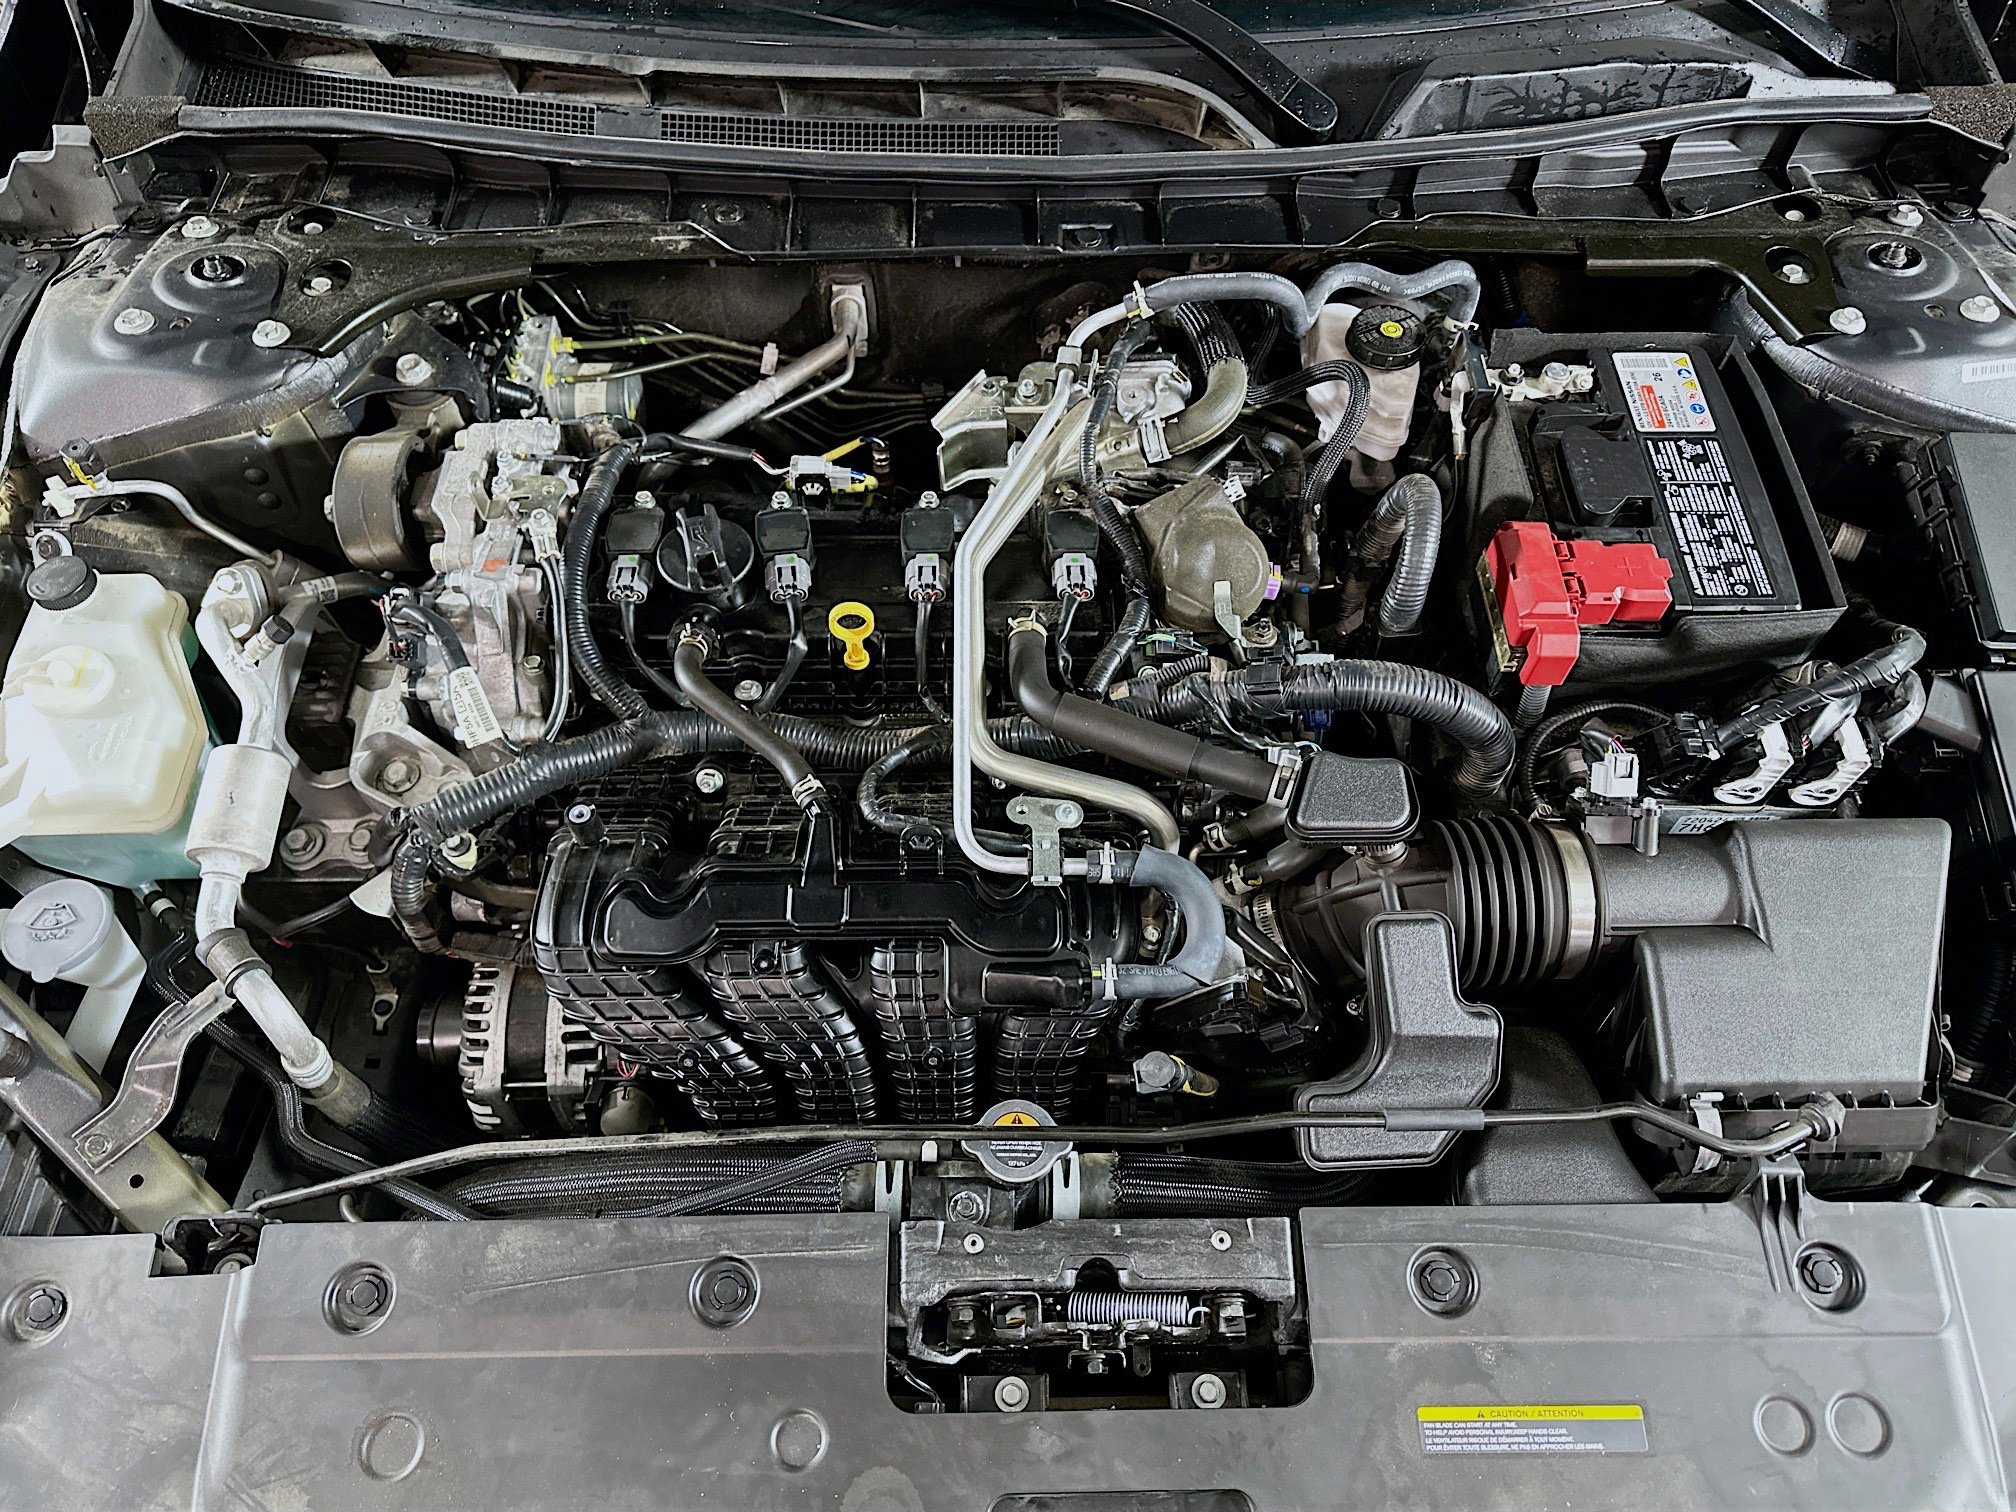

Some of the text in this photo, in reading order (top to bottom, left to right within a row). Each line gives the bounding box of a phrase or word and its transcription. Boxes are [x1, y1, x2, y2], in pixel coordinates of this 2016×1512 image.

[1652, 372, 1662, 381] 26
[1625, 381, 1645, 428] RENAULT NISSAN
[1088, 868, 1101, 877] SAE
[1490, 1410, 1528, 1418] CAUTION
